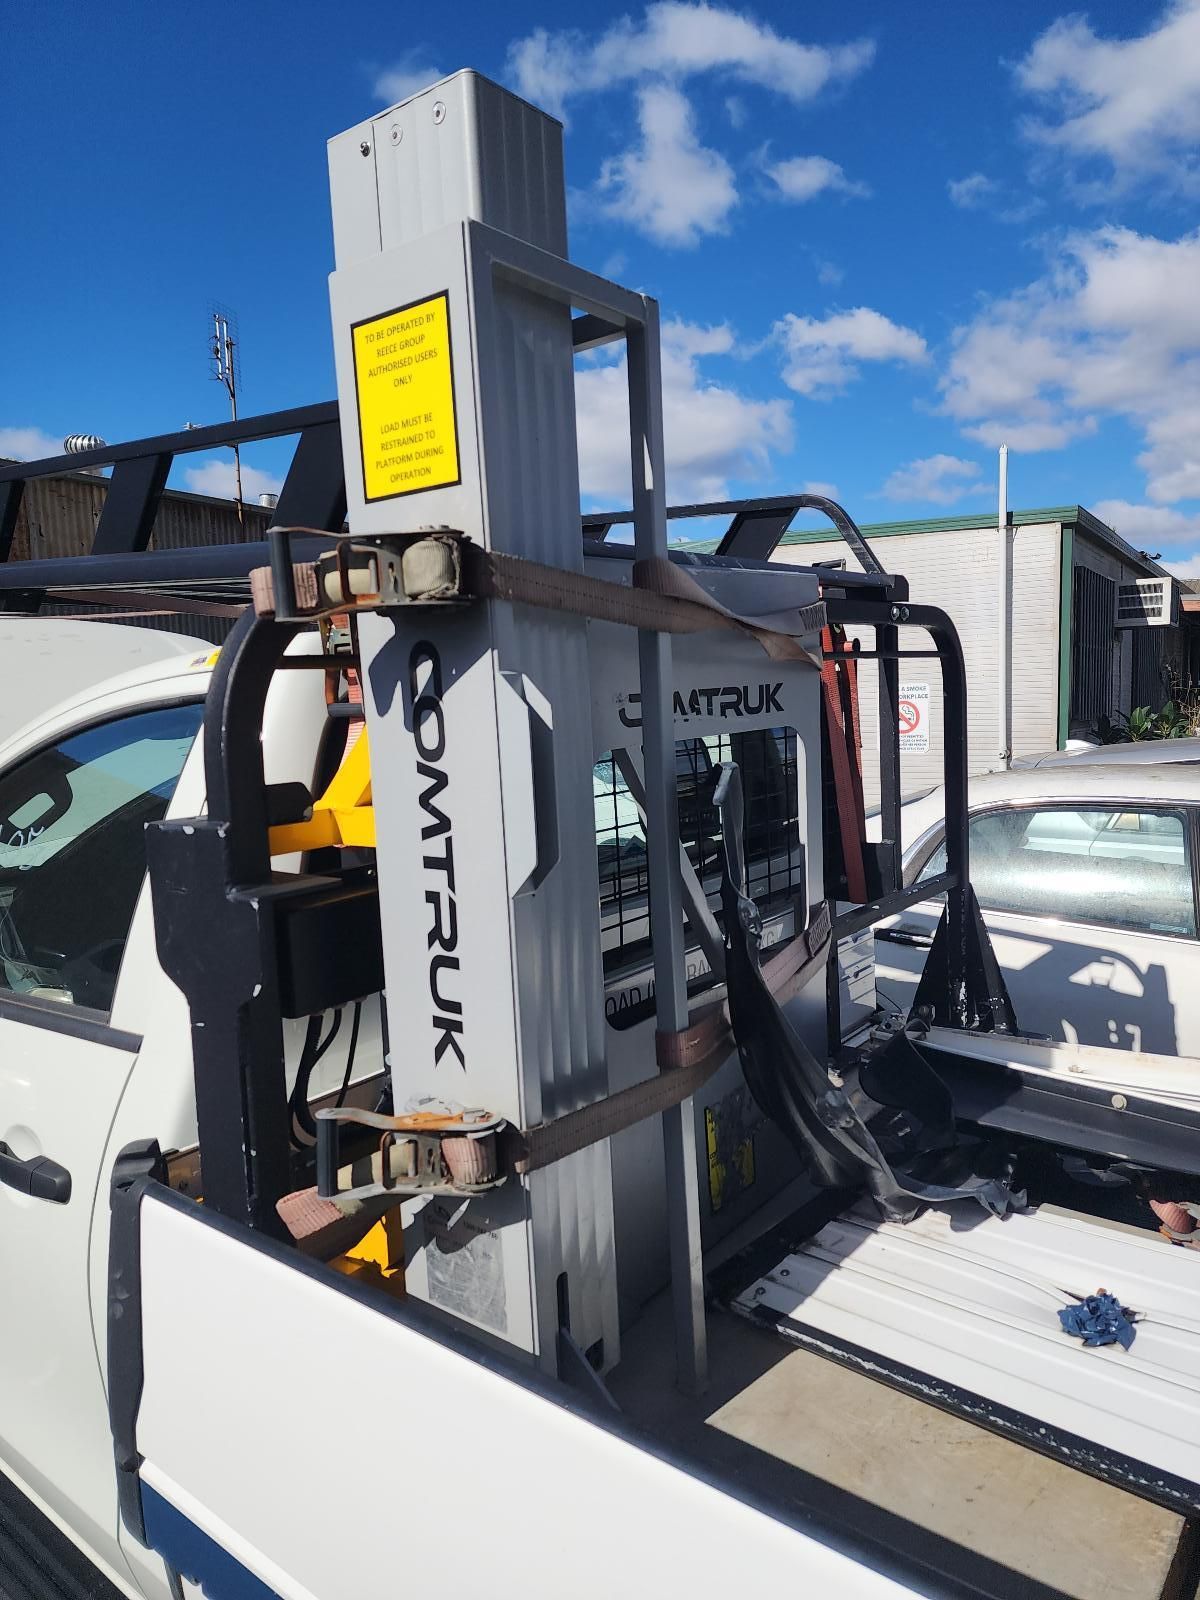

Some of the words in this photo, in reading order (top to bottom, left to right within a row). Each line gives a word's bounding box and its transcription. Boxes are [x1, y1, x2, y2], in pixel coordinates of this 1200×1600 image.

[365, 334, 375, 344] TO
[376, 329, 385, 340] BE
[386, 316, 425, 337] OPERATED
[426, 312, 436, 323] BY
[376, 343, 397, 358] REECE
[399, 333, 426, 350] GROUP
[368, 356, 413, 378] AUTHORISED
[414, 347, 438, 363] USERS
[393, 374, 413, 387] ONLY
[380, 422, 400, 435] LOAD
[401, 415, 422, 429] MUST
[423, 412, 433, 423] BE
[380, 433, 424, 451] RESTRAINED
[425, 429, 436, 440] TO
[375, 453, 413, 469] PLATFORM
[414, 445, 445, 460] DURING
[390, 466, 432, 483] OPERATION
[618, 682, 785, 728] CMTRUK
[408, 639, 467, 1073] COMTRUK
